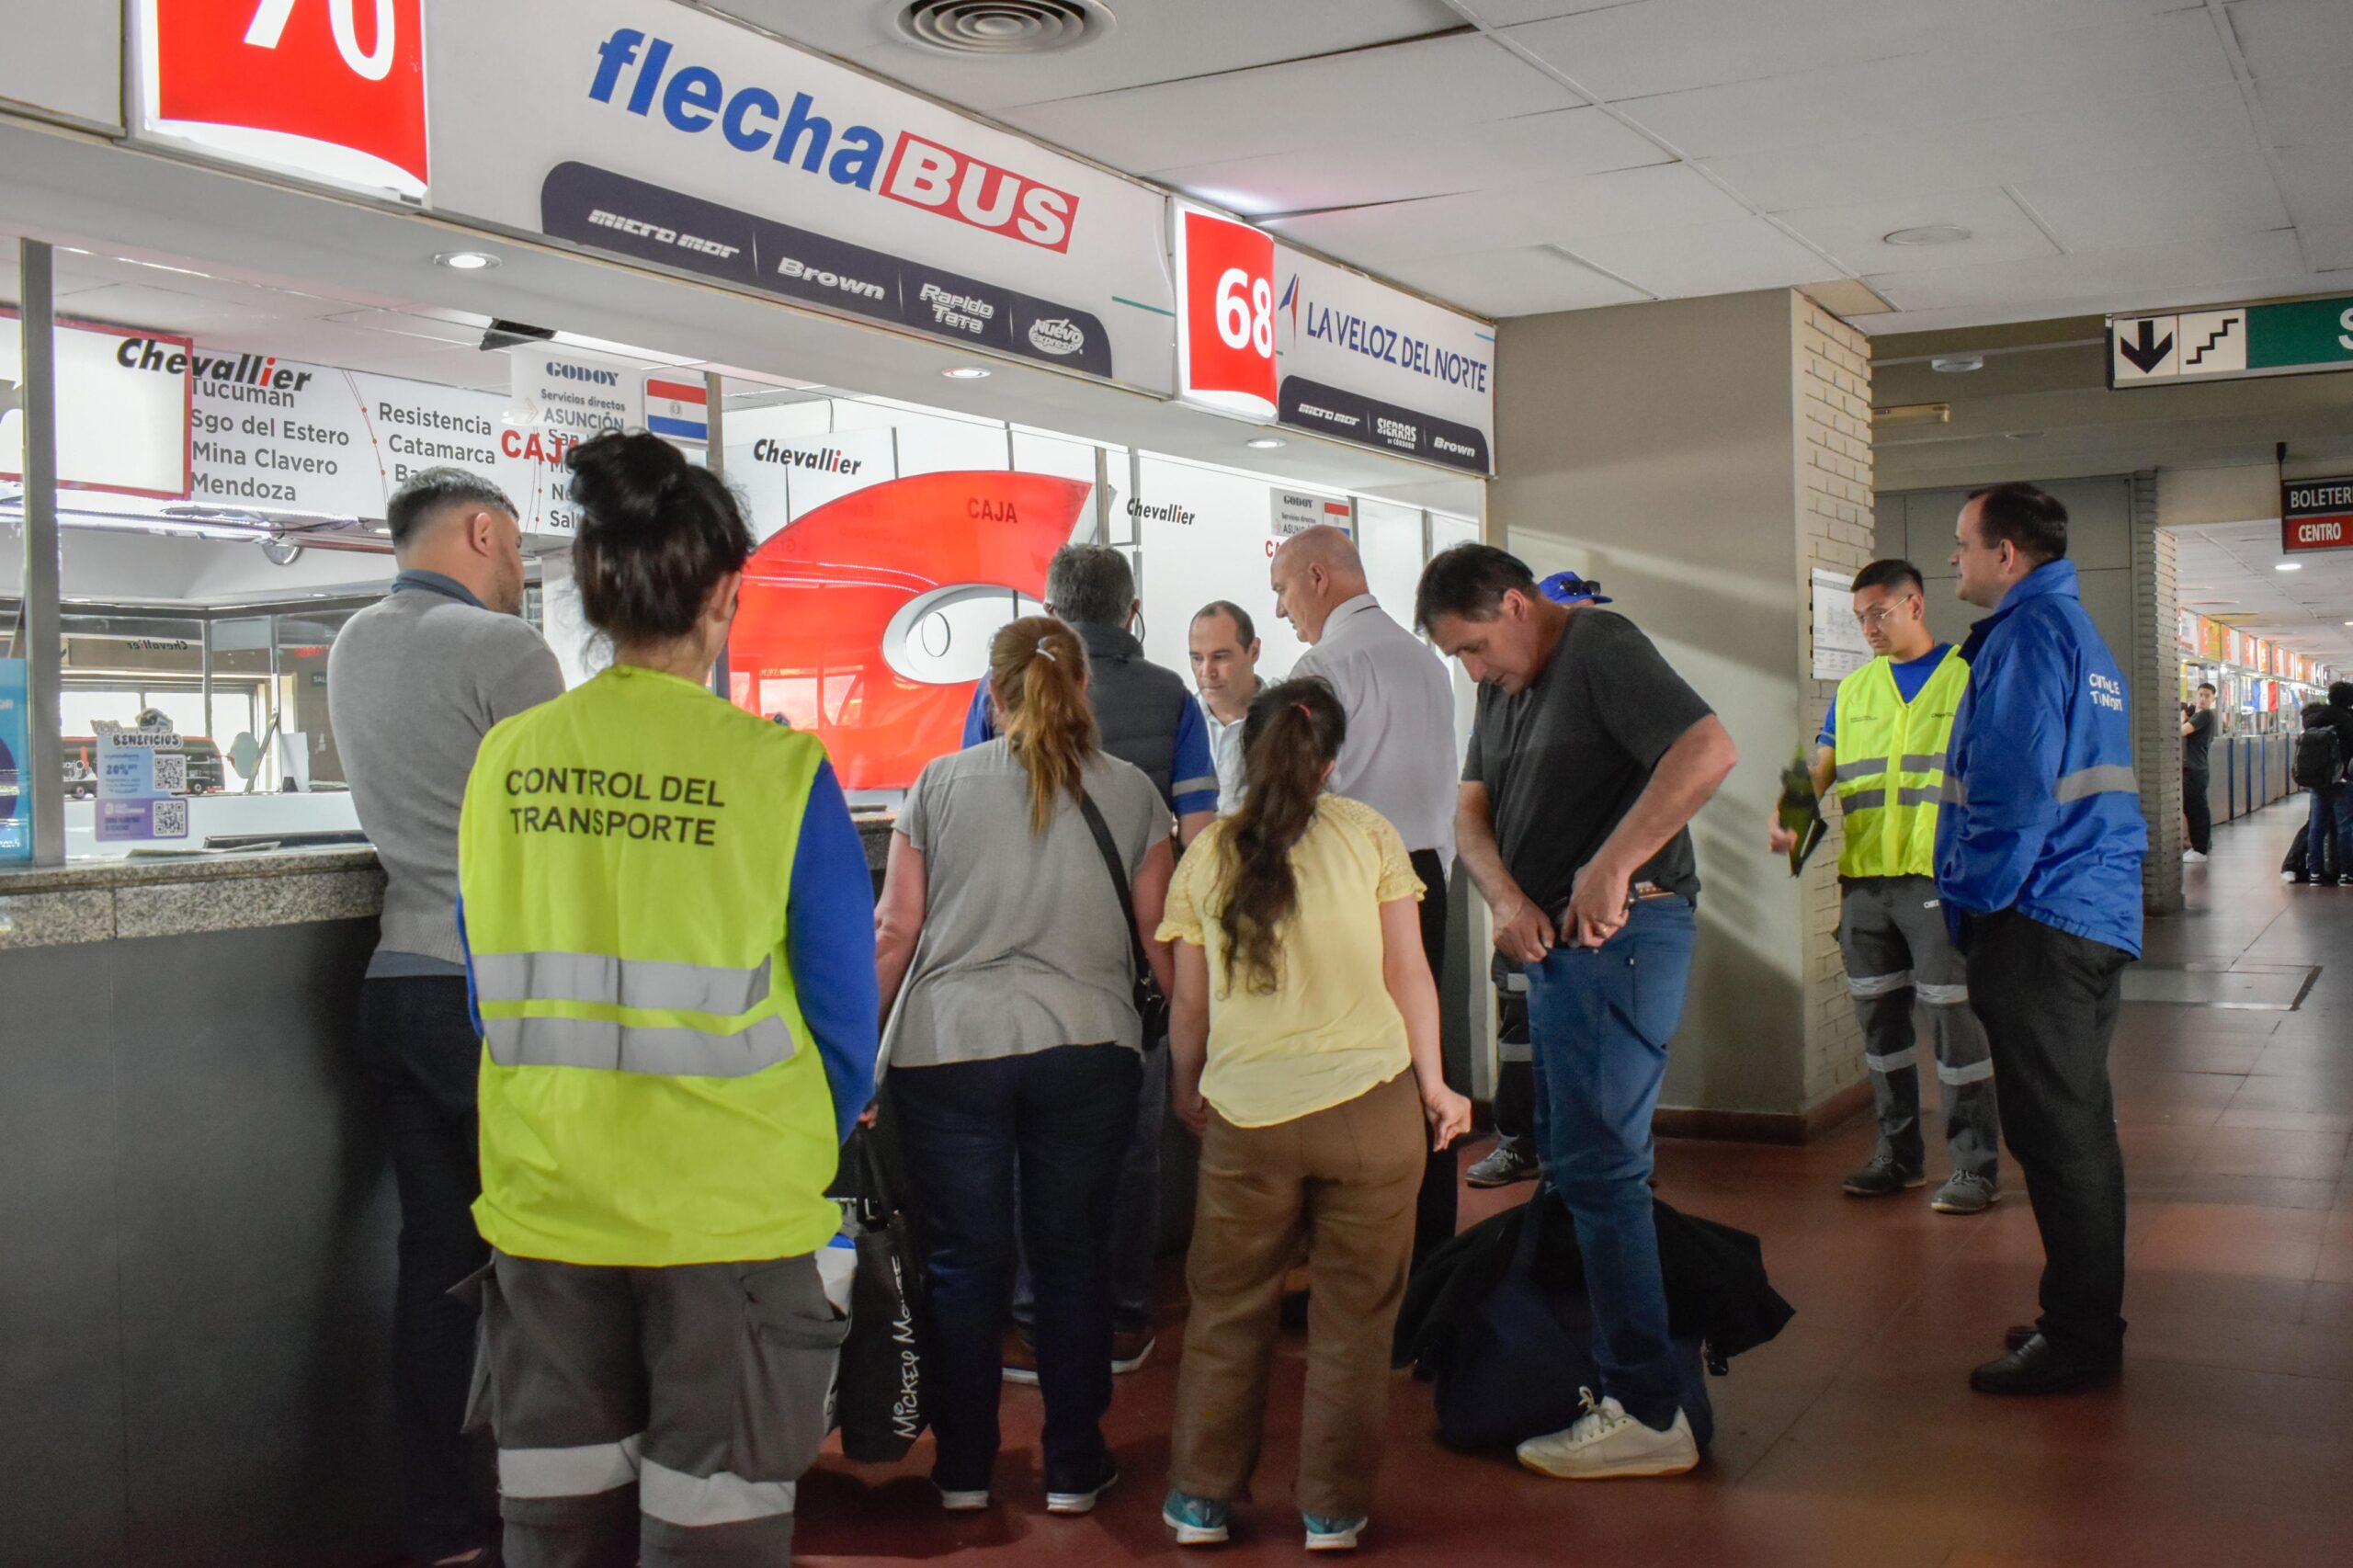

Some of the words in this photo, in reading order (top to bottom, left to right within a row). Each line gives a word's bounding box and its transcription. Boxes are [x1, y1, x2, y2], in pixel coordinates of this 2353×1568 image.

[778, 257, 885, 301] Brown
[1215, 267, 1273, 358] 68
[1307, 301, 1333, 343] LA
[1336, 311, 1397, 364] VELOZ
[1402, 336, 1431, 375] DEL
[1435, 347, 1487, 393] NORTE
[117, 337, 313, 392] Chevallier
[546, 361, 620, 387] GODOY
[540, 388, 585, 405] Servicios
[588, 395, 626, 412] directos
[191, 408, 233, 434] Sgo
[242, 415, 275, 437] del
[283, 420, 349, 446] Estero
[379, 402, 492, 436] Resistencia
[543, 407, 624, 430] ASUNCIÓN
[1377, 417, 1417, 442] SIERRAS
[192, 440, 246, 466] Mina
[255, 448, 338, 475] Clavero
[389, 434, 495, 464] Catamarca
[753, 438, 862, 476] Chevallier
[1433, 437, 1475, 457] Brown
[190, 472, 296, 501] Mendoza
[550, 510, 580, 529] Sal
[968, 496, 1017, 524] CAJA
[1126, 497, 1196, 526] Chevallier
[2299, 522, 2341, 542] CENTRO
[113, 734, 179, 746] BENEFICIOS
[506, 767, 651, 801] CONTROL
[660, 775, 725, 808] DEL
[510, 806, 716, 846] TRANSPORTE
